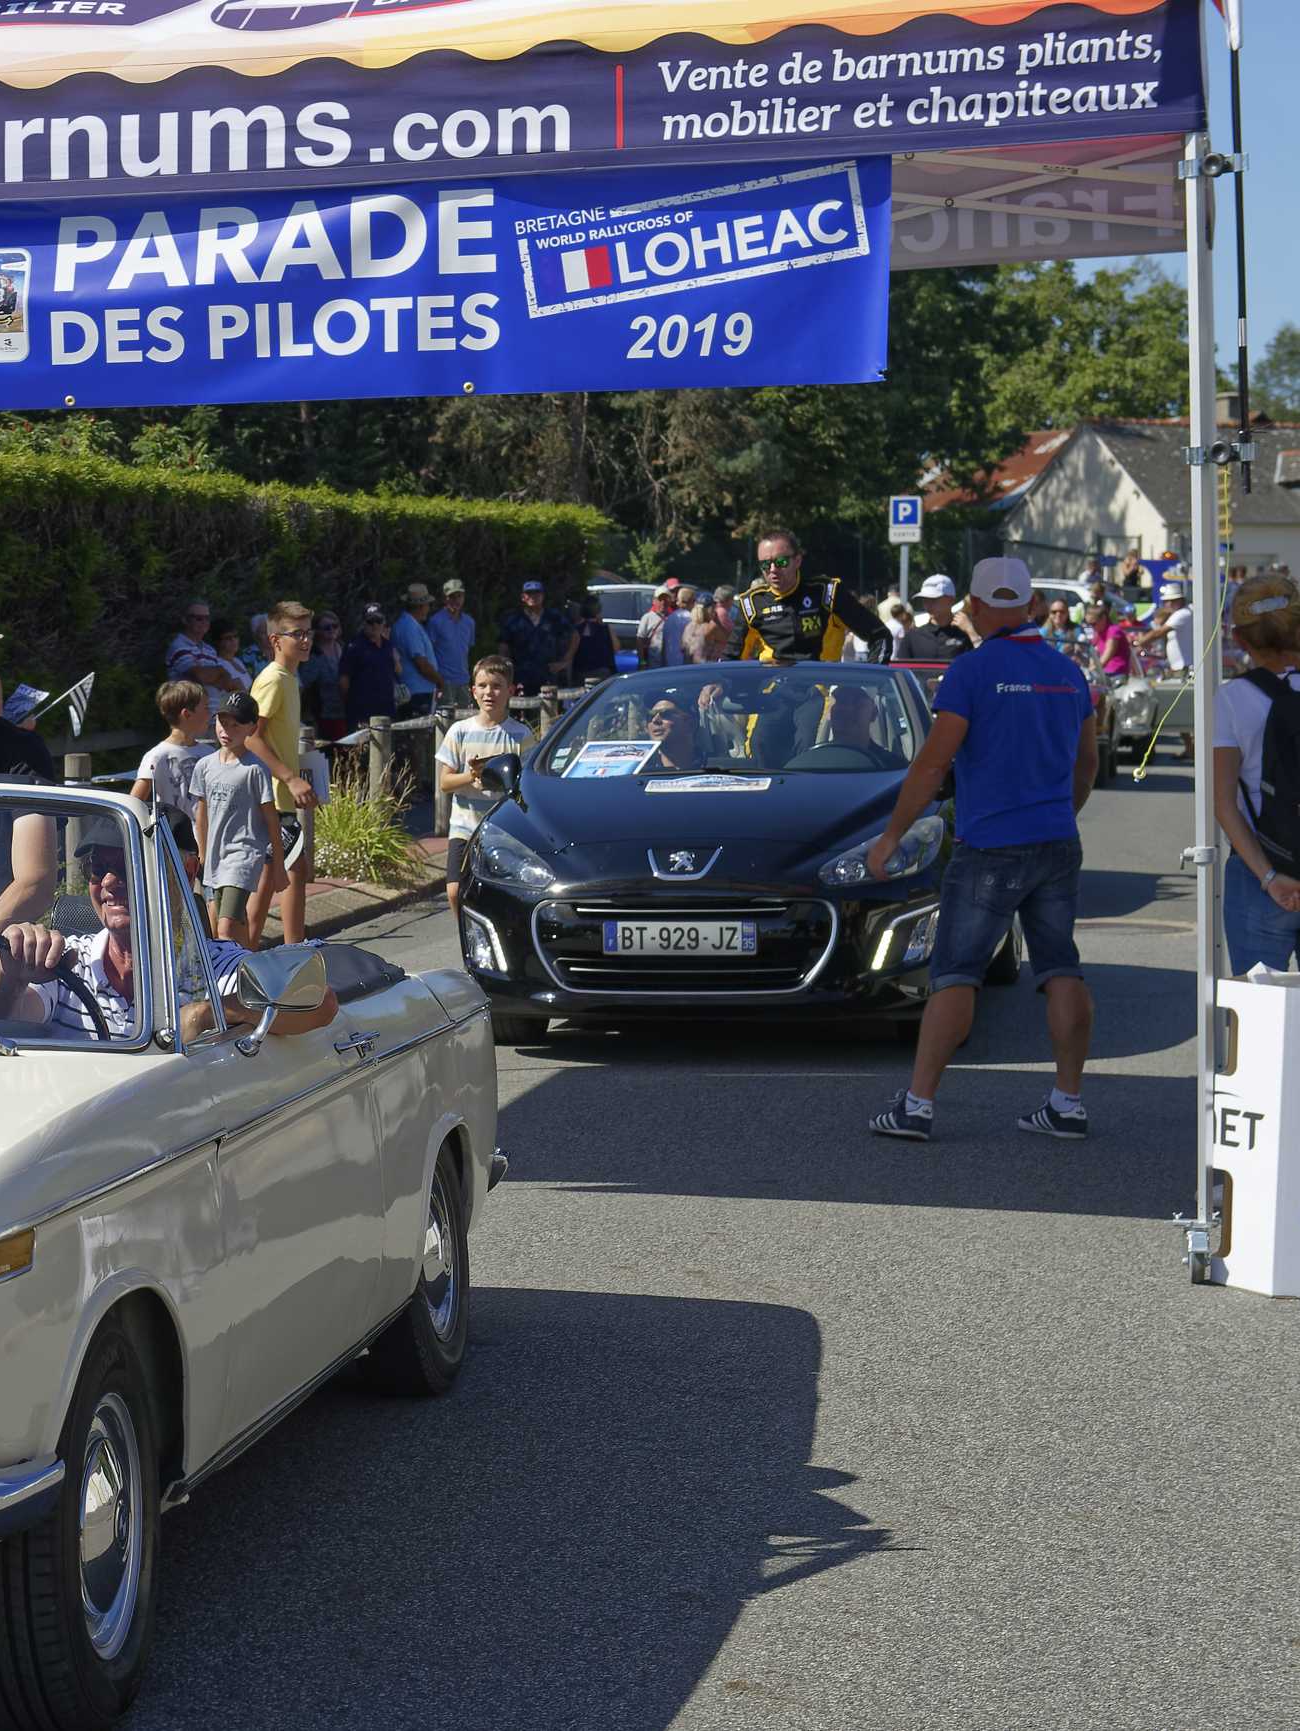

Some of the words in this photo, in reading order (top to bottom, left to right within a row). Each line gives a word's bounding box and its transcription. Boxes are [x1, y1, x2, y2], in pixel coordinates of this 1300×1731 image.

[658, 57, 768, 92] Vente
[778, 53, 822, 86] de
[832, 43, 1005, 82] barnums
[1016, 30, 1163, 75] pliants,
[662, 97, 841, 140] mobilier
[852, 95, 894, 127] et
[906, 80, 1159, 127] chapiteaux
[53, 188, 497, 293] PARADE
[515, 206, 606, 235] BRETAGNE
[536, 230, 586, 249] WORLD
[589, 216, 672, 242] RALLYCROSS
[674, 210, 693, 225] OF
[615, 199, 849, 284] LOHEAC
[50, 305, 185, 366] DES
[209, 292, 501, 360] PILOTES
[626, 311, 752, 359] 2019
[898, 502, 912, 521] P
[996, 683, 1032, 693] France
[620, 926, 739, 950] BT-929-JZ
[742, 937, 755, 950] 35
